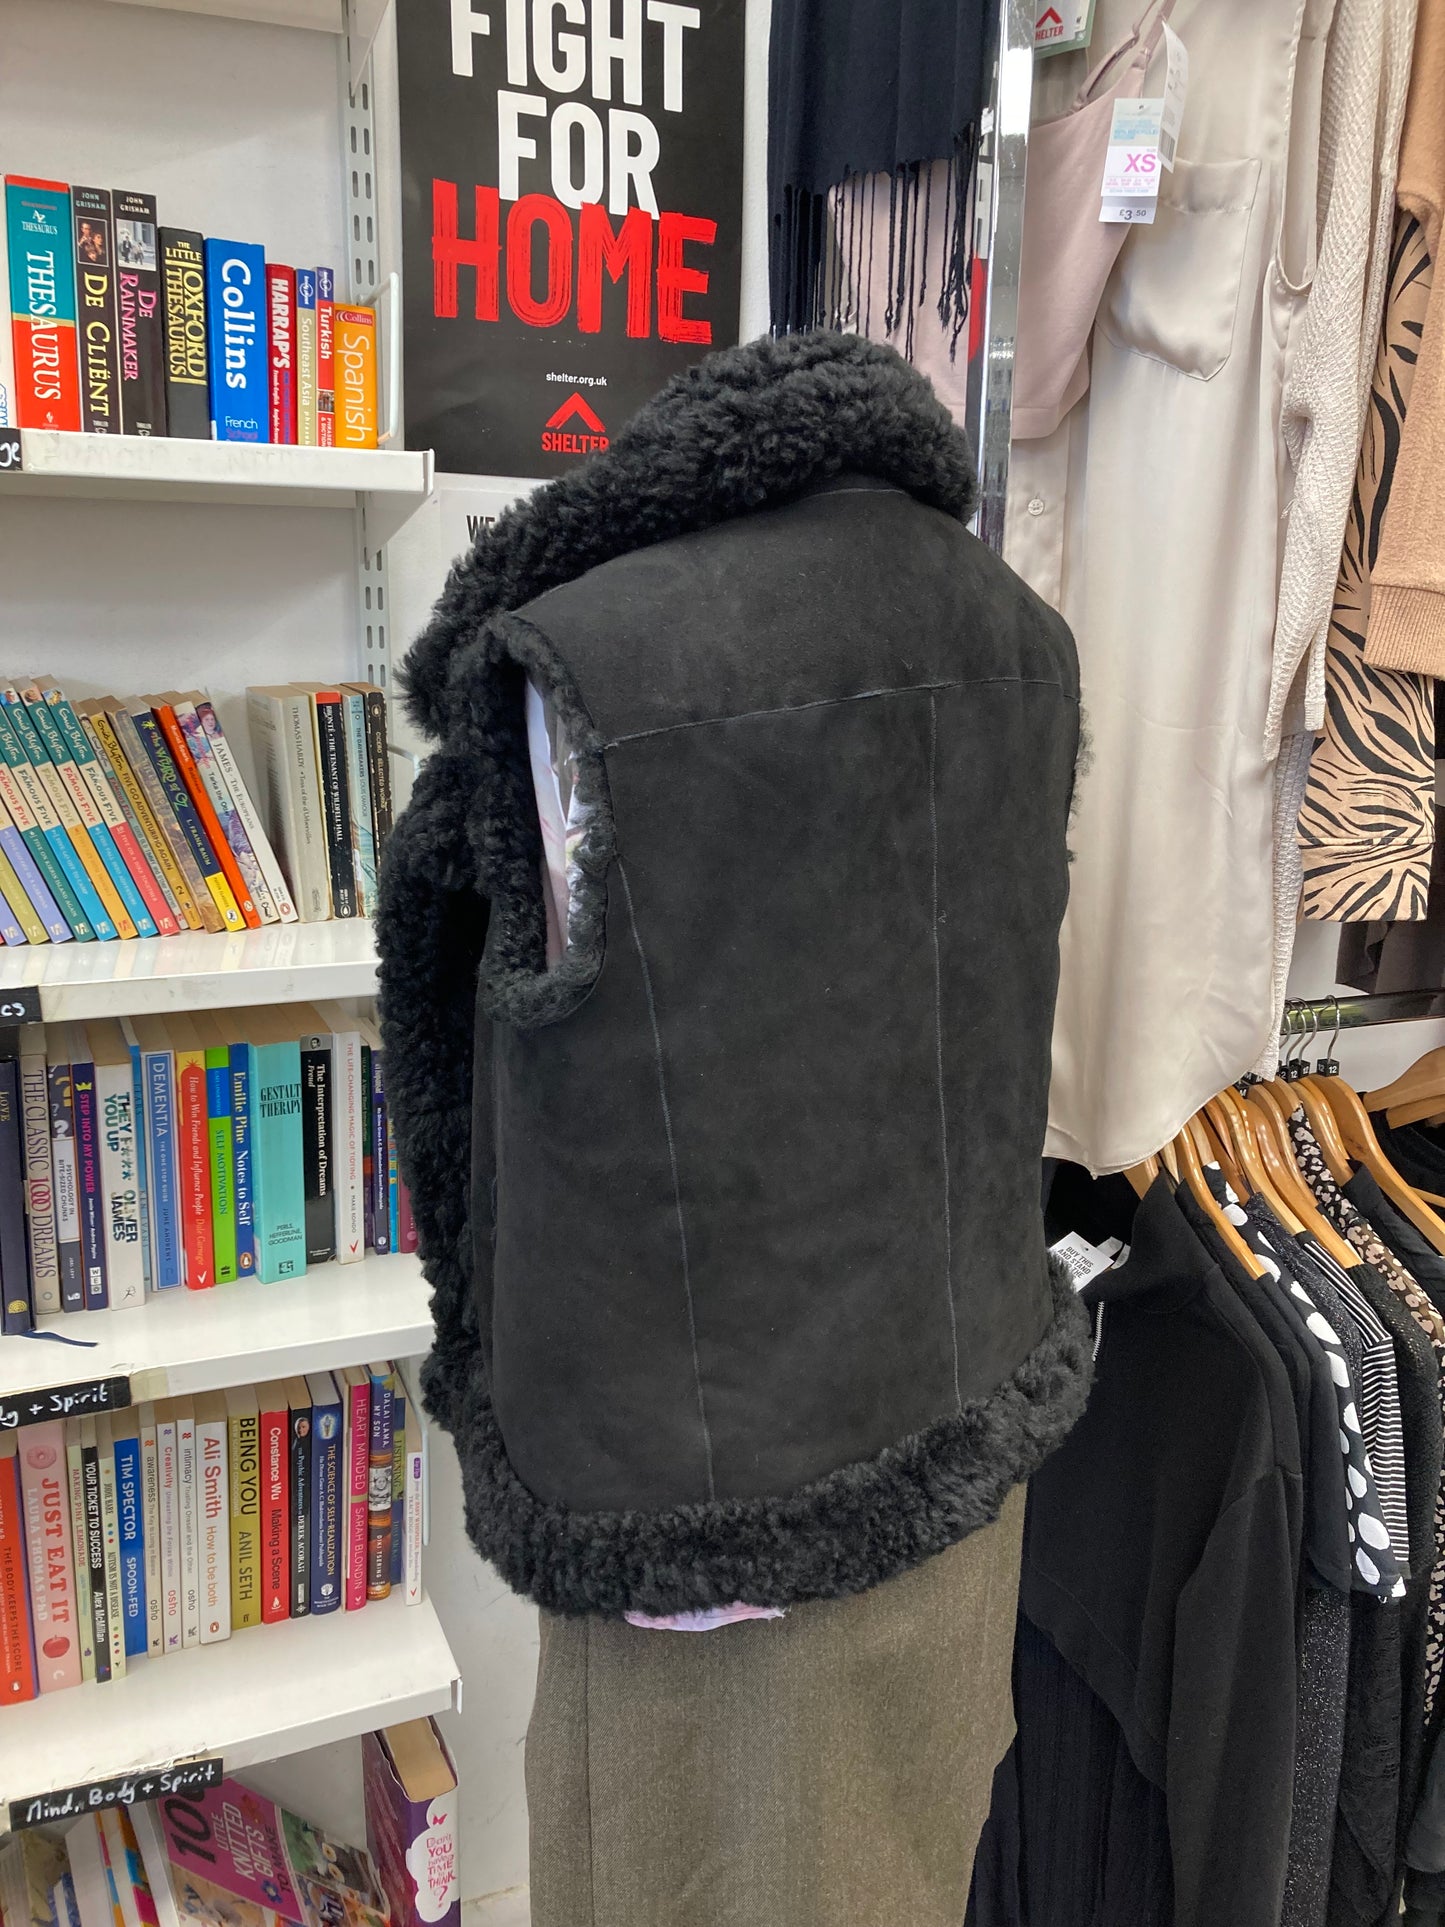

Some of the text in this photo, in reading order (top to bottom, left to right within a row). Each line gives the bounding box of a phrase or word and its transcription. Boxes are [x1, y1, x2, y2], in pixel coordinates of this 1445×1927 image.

[1035, 25, 1063, 40] HELTER
[450, 0, 700, 112] FIGHT
[497, 89, 660, 220] FOR
[1125, 153, 1157, 173] XS
[82, 192, 100, 201] JOHN
[126, 196, 144, 205] JOHN
[165, 247, 202, 262] LITTLE
[177, 241, 191, 249] THE
[432, 178, 718, 344] HOME
[26, 250, 61, 399] THESAURUS
[166, 268, 187, 376] THESAURUS
[183, 270, 207, 377] OXFORD
[222, 258, 255, 389] Collins
[271, 278, 290, 368] HARRAP'S
[320, 306, 331, 359] Turkish
[345, 311, 372, 324] Collins
[299, 317, 313, 377] Southeast
[301, 380, 311, 405] Asia
[337, 333, 372, 442] Spanish
[546, 372, 607, 387] shelter.org.uk
[225, 416, 258, 430] French
[541, 432, 609, 454] SHELTER
[375, 731, 383, 753] CICERO
[329, 754, 338, 780] TENANT
[332, 781, 338, 789] OF
[17, 768, 51, 825] FAMOUS FIVE
[63, 766, 84, 801] FAMOUS
[80, 802, 96, 822] FIVE
[332, 791, 341, 822] WILDFELL
[260, 1083, 302, 1102] GESTALT
[307, 1065, 315, 1087] Freud
[118, 1091, 131, 1132] THEY
[152, 1062, 169, 1136] DEMENTIA
[260, 1099, 302, 1118] THERAPY
[79, 1093, 94, 1193] STEP INTO MY POWER
[104, 1094, 119, 1151] YOU UP
[215, 1129, 225, 1149] SELF
[315, 1064, 327, 1196] The Interpretation of Dreams
[188, 1076, 204, 1215] How to Win Friends and Influence People
[233, 1071, 250, 1225] Emilie Pine Notes to Self
[21, 1069, 56, 1278] THE CLASSIC 1000 DREAMS
[216, 1152, 229, 1214] MOTIVATION
[109, 1191, 125, 1240] JAMES
[268, 1235, 302, 1246] GOODMAN
[1065, 1246, 1094, 1268] BUY THIS
[1070, 1258, 1091, 1275] STAND
[49, 1383, 108, 1413] Spirit
[372, 1405, 380, 1436] MY SON
[182, 1448, 193, 1483] intimacy
[240, 1417, 256, 1514] BEING YOU
[268, 1427, 282, 1500] Constance Wu
[355, 1399, 364, 1489] HEART MINDED
[147, 1456, 155, 1502] awareness
[163, 1446, 173, 1488] Creativity
[203, 1437, 222, 1518] Ali Smith
[27, 1488, 40, 1533] LAURA
[85, 1462, 102, 1568] YOUR TICKET TO SUCCESS
[120, 1454, 138, 1539] TIM SPECTOR
[328, 1494, 335, 1504] OF
[269, 1508, 282, 1546] Making
[327, 1506, 335, 1575] SELF-REALIZATION
[354, 1507, 363, 1589] SARAH BLONDIN
[3, 1547, 11, 1564] THE
[31, 1537, 45, 1591] THOMAS
[41, 1477, 69, 1623] JUST EAT IT
[206, 1526, 218, 1606] How to be both
[239, 1532, 251, 1600] ANIL SETH
[5, 1567, 15, 1590] BODY
[125, 1557, 139, 1616] SPOON-FED
[271, 1558, 283, 1589] Scene
[8, 1594, 17, 1621] KEEPS
[93, 1591, 106, 1642] Alex McMillan
[150, 1599, 159, 1620] osho
[167, 1589, 178, 1615] osho
[188, 1589, 198, 1610] osho
[10, 1624, 18, 1639] THE
[12, 1642, 21, 1671] SCORE
[89, 1781, 135, 1804] Body
[160, 1764, 215, 1792] Spirit
[164, 1788, 216, 1863] 10
[222, 1802, 257, 1881] KNITTED
[246, 1825, 274, 1878] GIFTS
[428, 1843, 452, 1857] YOU
